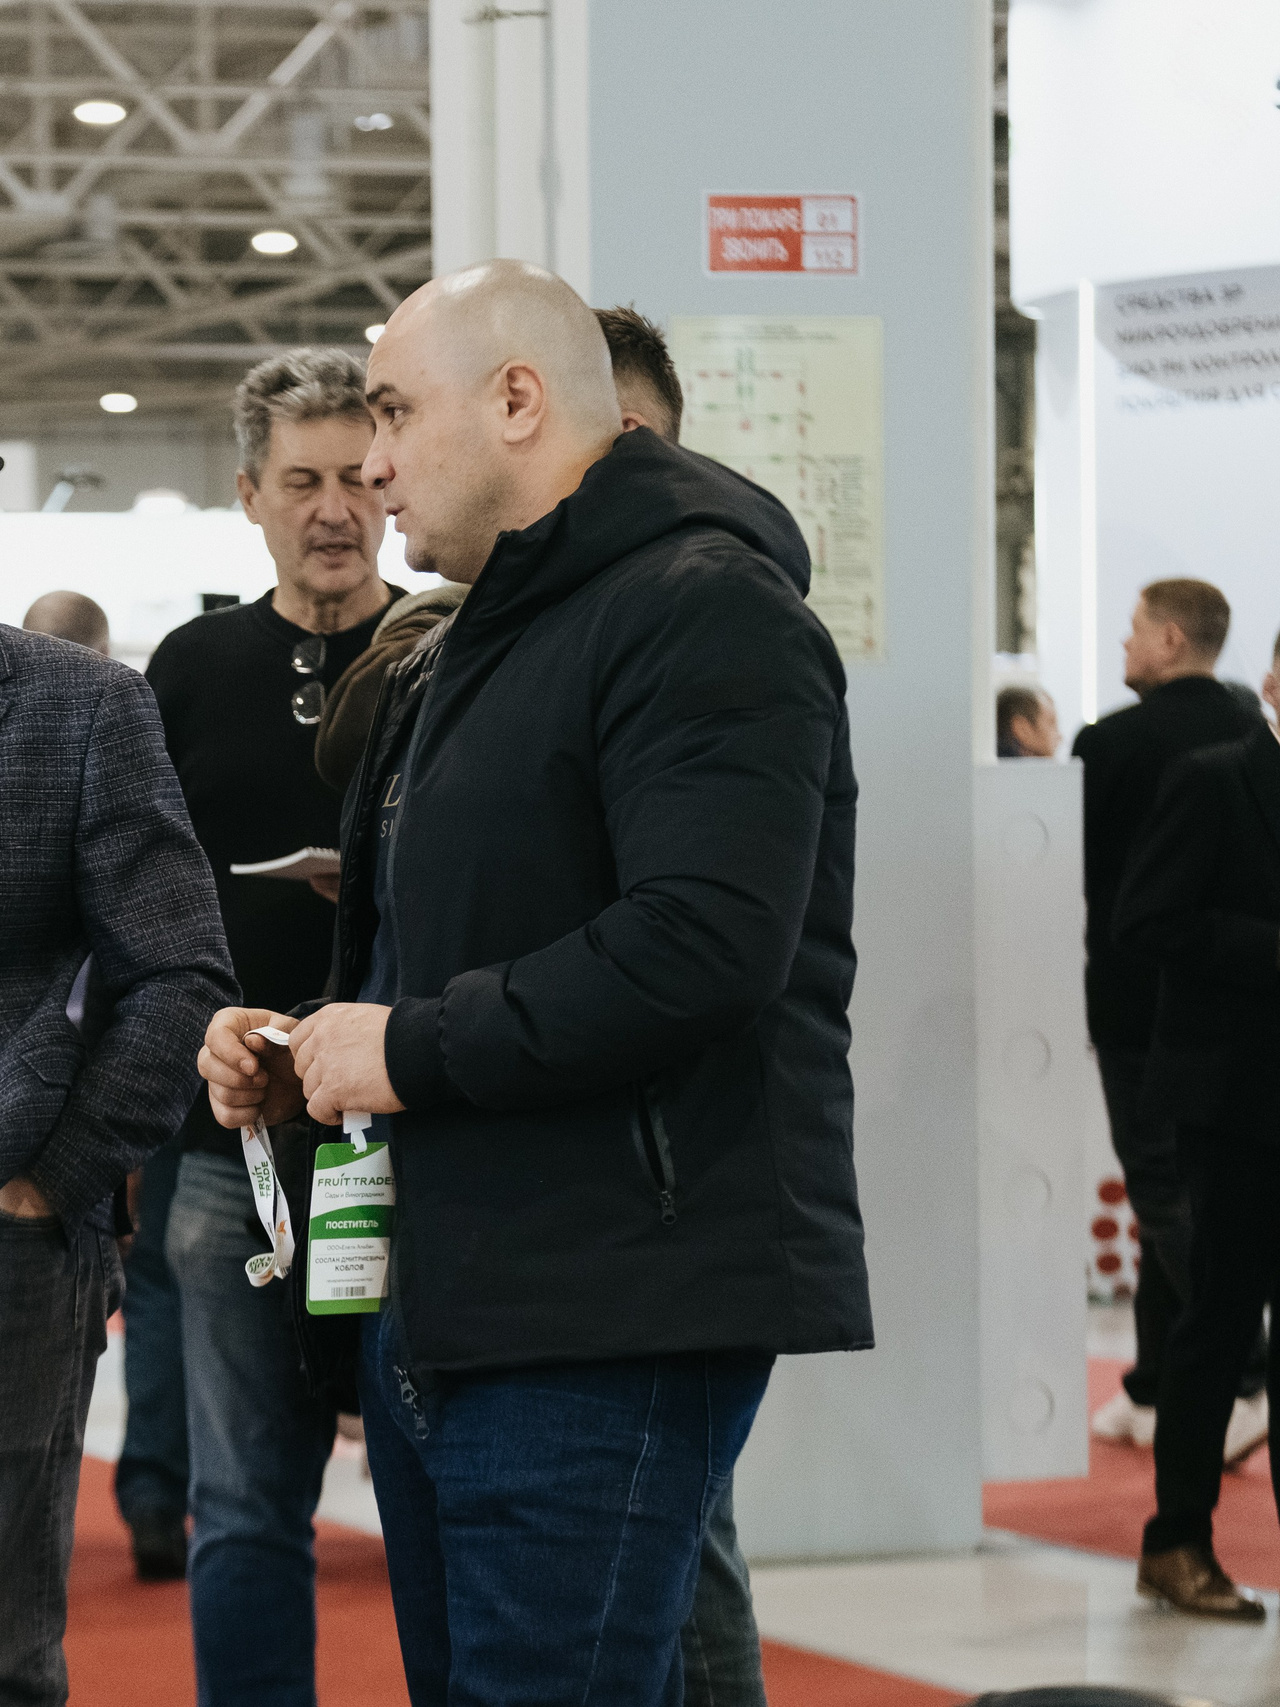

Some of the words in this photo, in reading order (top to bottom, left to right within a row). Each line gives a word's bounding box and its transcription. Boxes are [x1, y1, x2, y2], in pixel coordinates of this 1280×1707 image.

[261, 1160, 271, 1199] TRADE
[352, 1176, 393, 1187] TRADE
[324, 1191, 340, 1199] Сады
[325, 1219, 380, 1230] ПОСЕТИТЕЛЬ
[334, 1263, 365, 1272] КОБЛОВ
